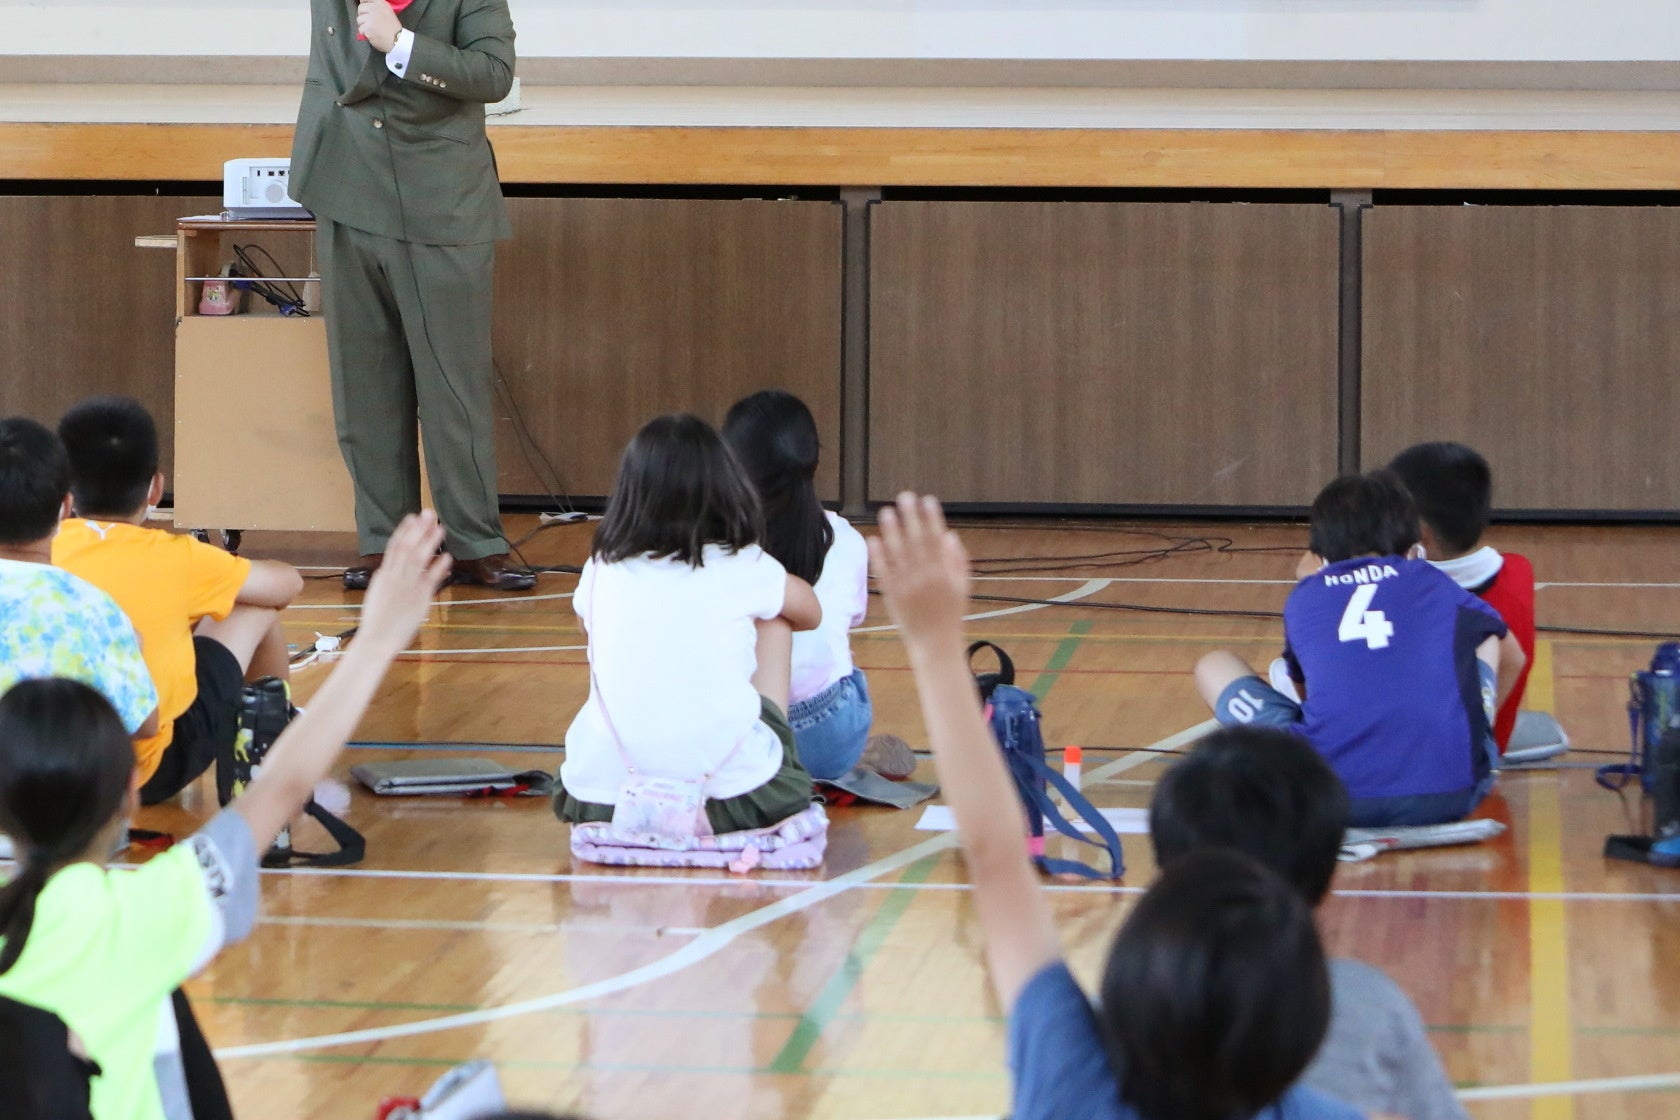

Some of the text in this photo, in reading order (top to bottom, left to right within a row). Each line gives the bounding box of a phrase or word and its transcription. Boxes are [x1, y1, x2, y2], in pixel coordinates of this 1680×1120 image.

[1324, 565, 1399, 587] HONDA
[1338, 583, 1394, 649] 4
[1228, 689, 1263, 723] 10
